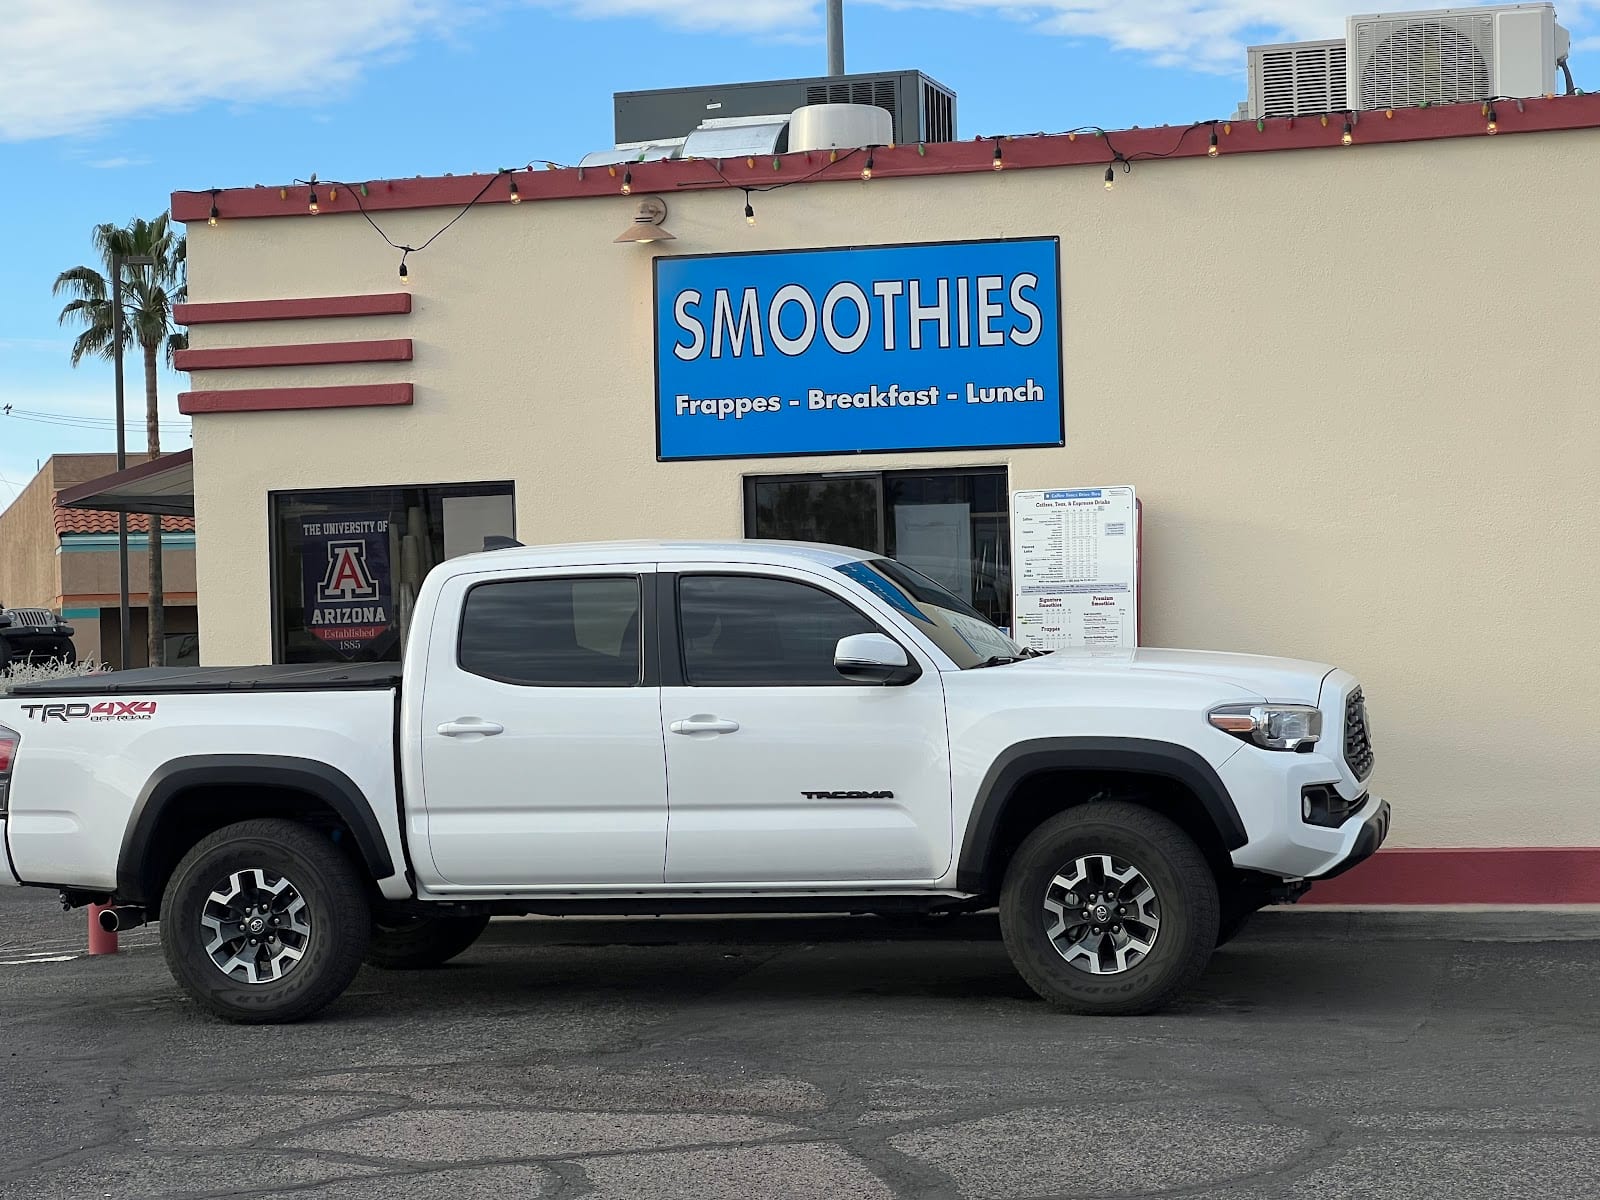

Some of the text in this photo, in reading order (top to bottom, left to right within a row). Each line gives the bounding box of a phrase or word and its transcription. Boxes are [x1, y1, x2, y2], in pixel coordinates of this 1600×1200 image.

[673, 273, 1042, 361] SMOOTHIES
[675, 393, 782, 420] Frappes
[808, 384, 939, 411] Breakfast
[966, 378, 1044, 405] Lunch
[303, 520, 389, 536] THE UNIVERSITY OF
[317, 539, 379, 603] A
[311, 606, 387, 625] ARIZONA
[324, 628, 375, 639] Established
[339, 640, 361, 650] 1885
[20, 703, 91, 723] TRD
[90, 714, 152, 723] OFF ROAD
[800, 791, 894, 800] TACOMA
